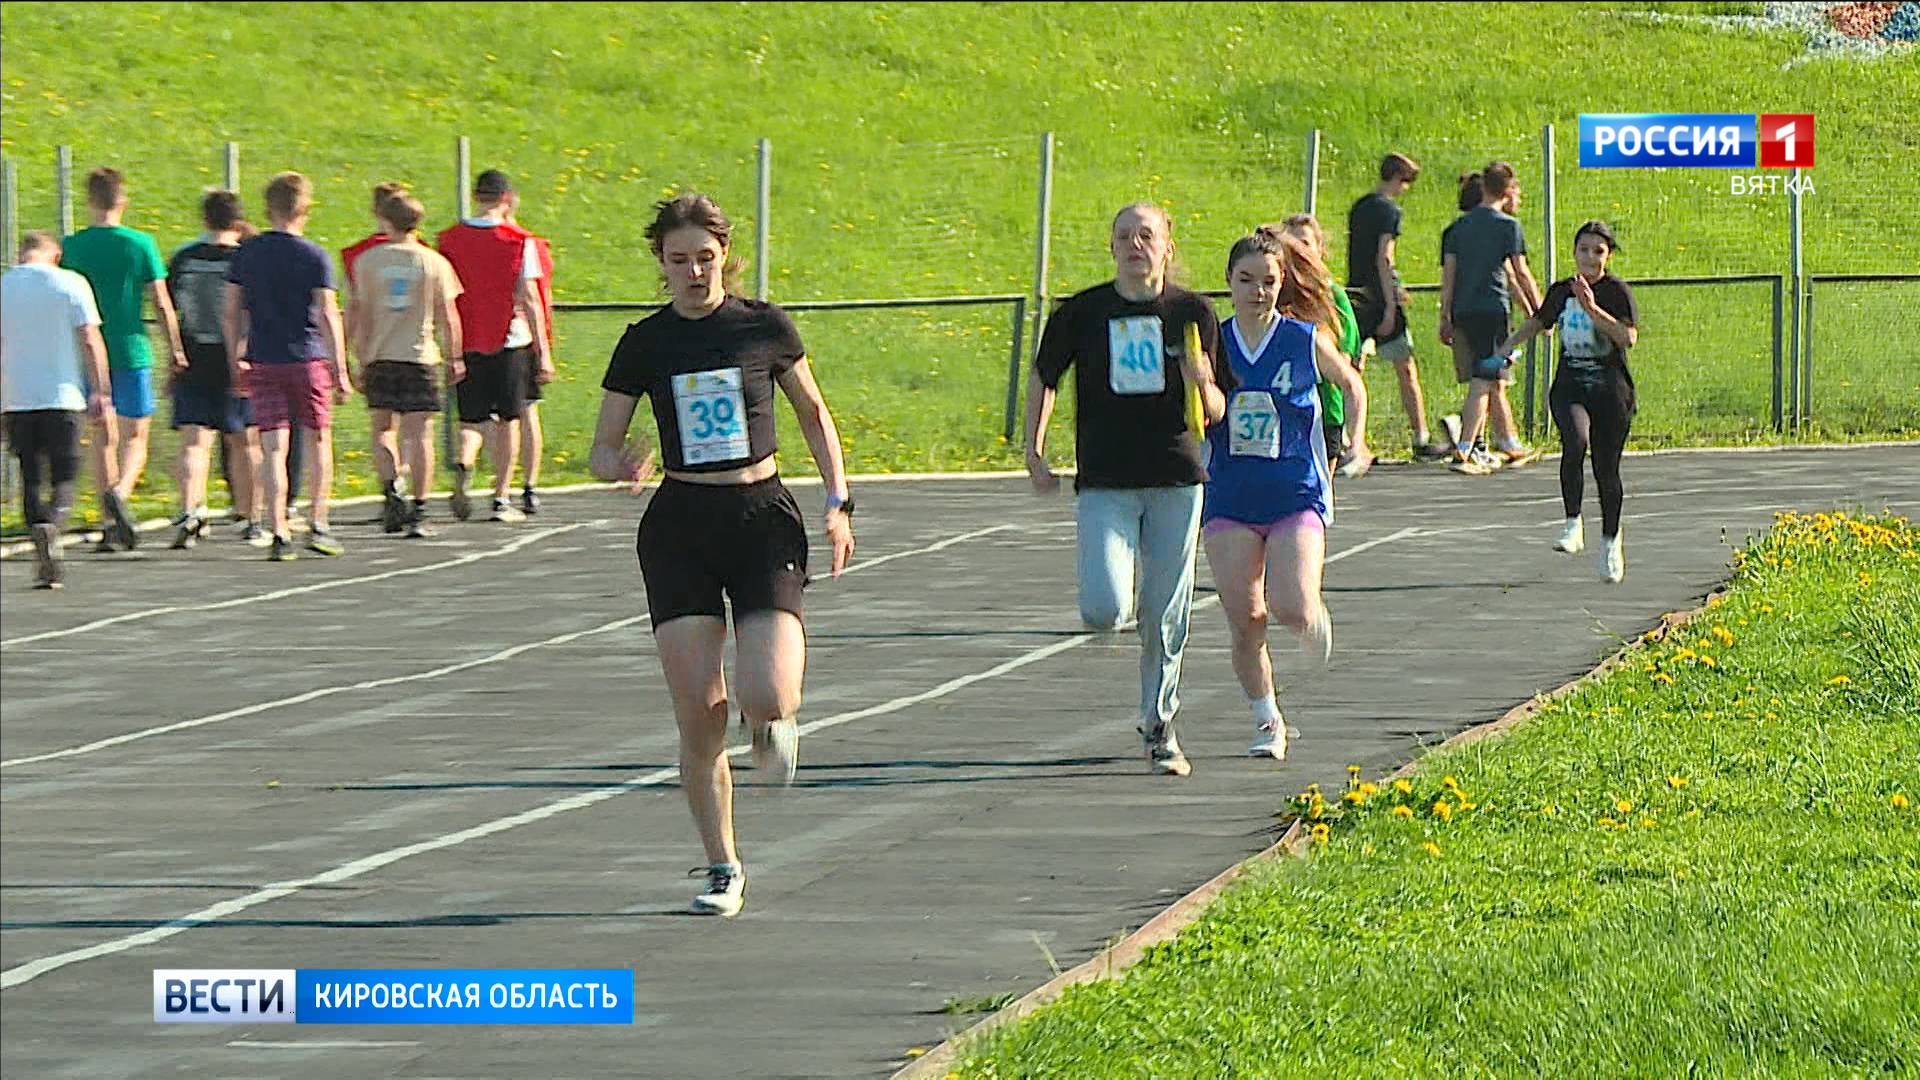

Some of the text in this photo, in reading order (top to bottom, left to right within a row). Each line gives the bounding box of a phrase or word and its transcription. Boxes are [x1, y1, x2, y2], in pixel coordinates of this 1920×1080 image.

[1119, 339, 1158, 373] 40
[1271, 361, 1293, 396] 4
[689, 397, 739, 438] 39
[1237, 412, 1272, 442] 37
